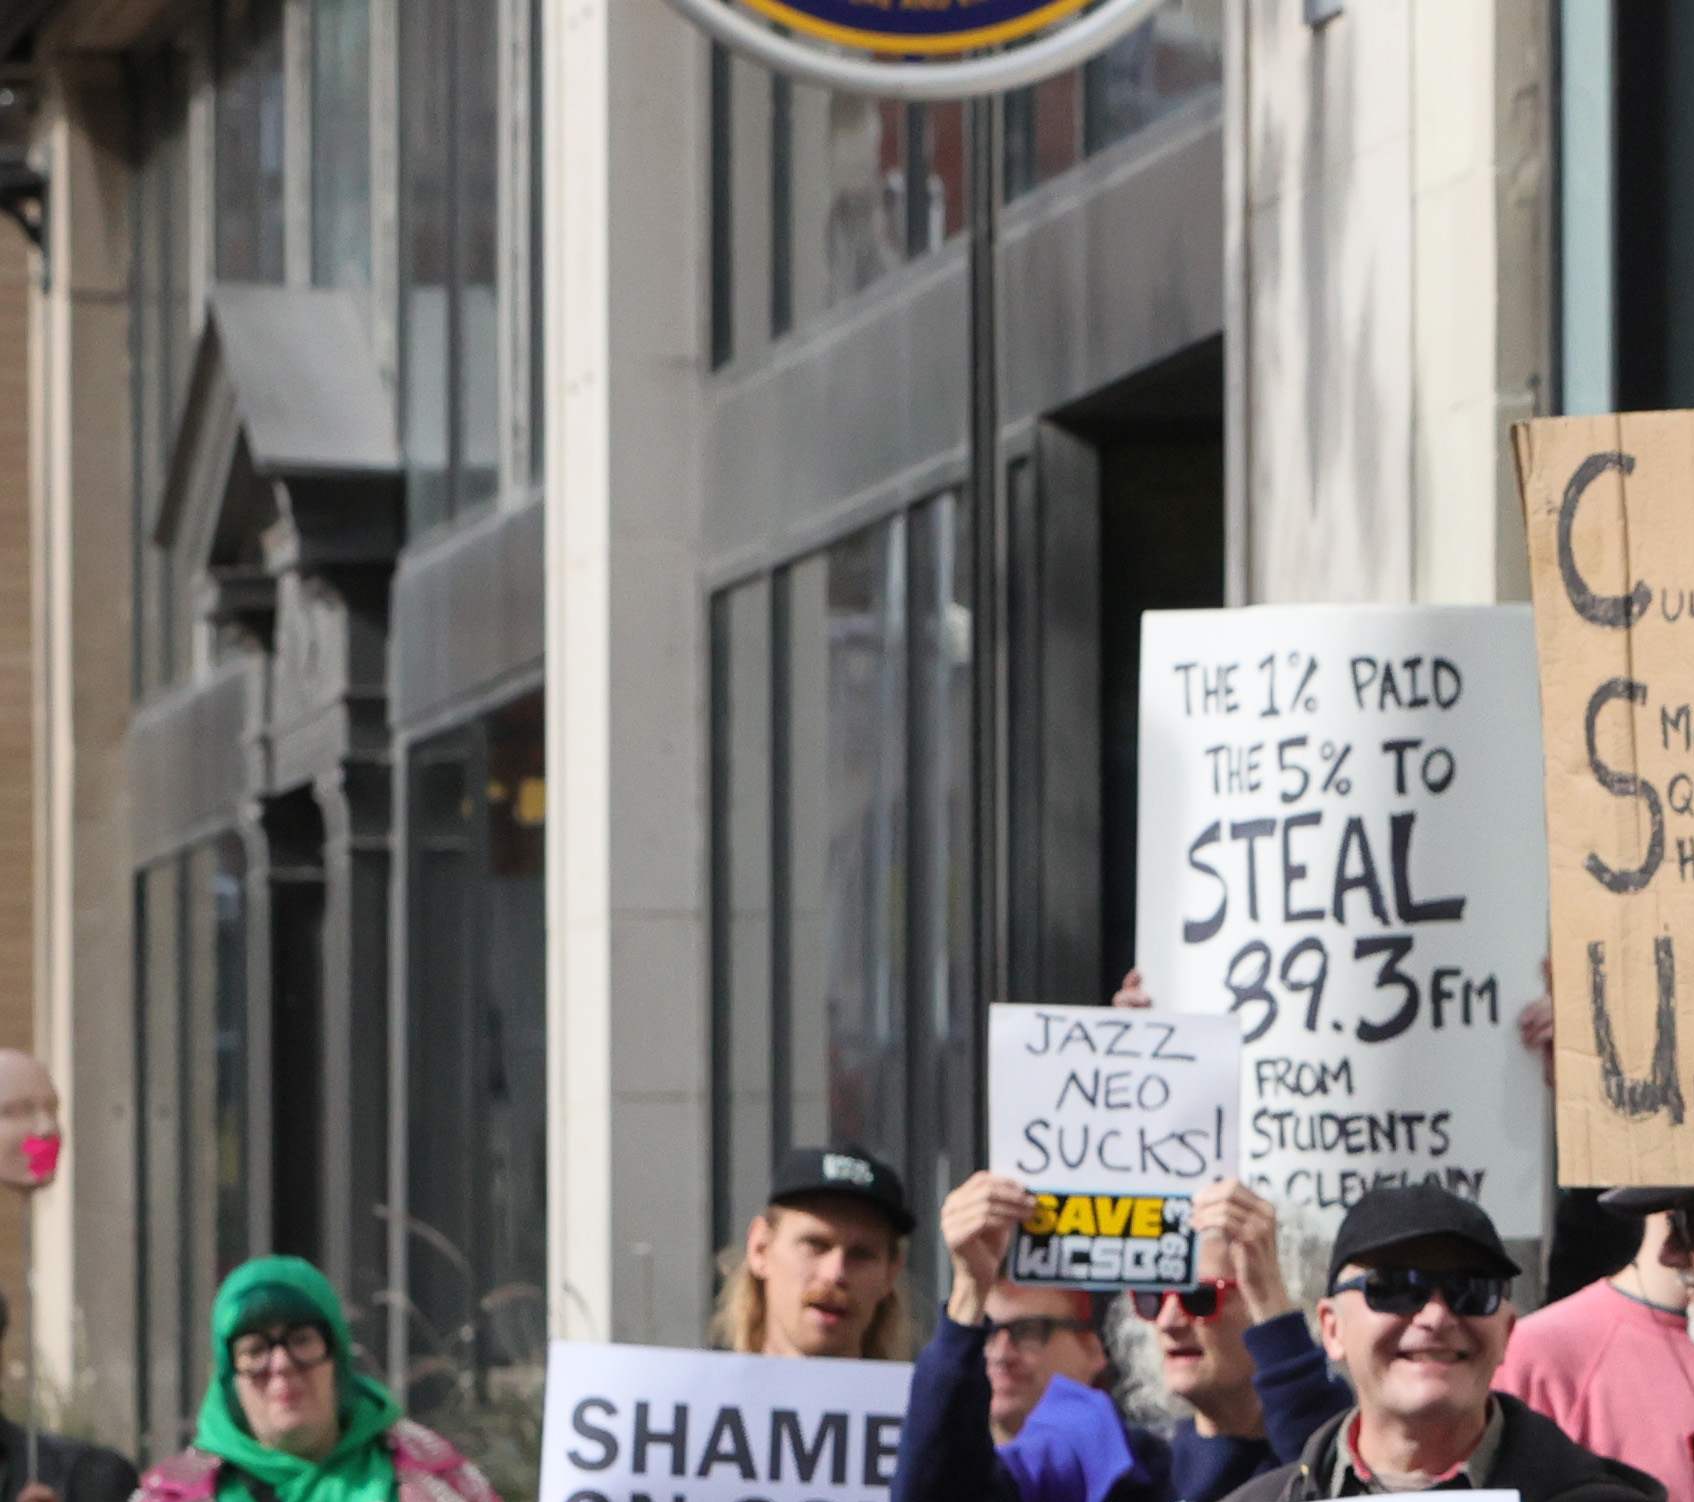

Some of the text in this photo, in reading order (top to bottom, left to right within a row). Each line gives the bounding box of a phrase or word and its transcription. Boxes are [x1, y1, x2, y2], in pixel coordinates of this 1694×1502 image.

[1174, 650, 1463, 718] THE 1% PAID
[1204, 734, 1457, 804] THE 5% TO
[1182, 810, 1468, 945] STEAL
[1222, 936, 1499, 1045] 89.3 FM
[1025, 1011, 1196, 1062] JAZZ
[1055, 1067, 1170, 1111] NEO
[1255, 1056, 1355, 1099] FROM
[1016, 1103, 1223, 1182] SUCKS!
[1250, 1109, 1452, 1161] STUDENTS
[1022, 1192, 1164, 1238] SAVE
[566, 1397, 907, 1488] SHAME
